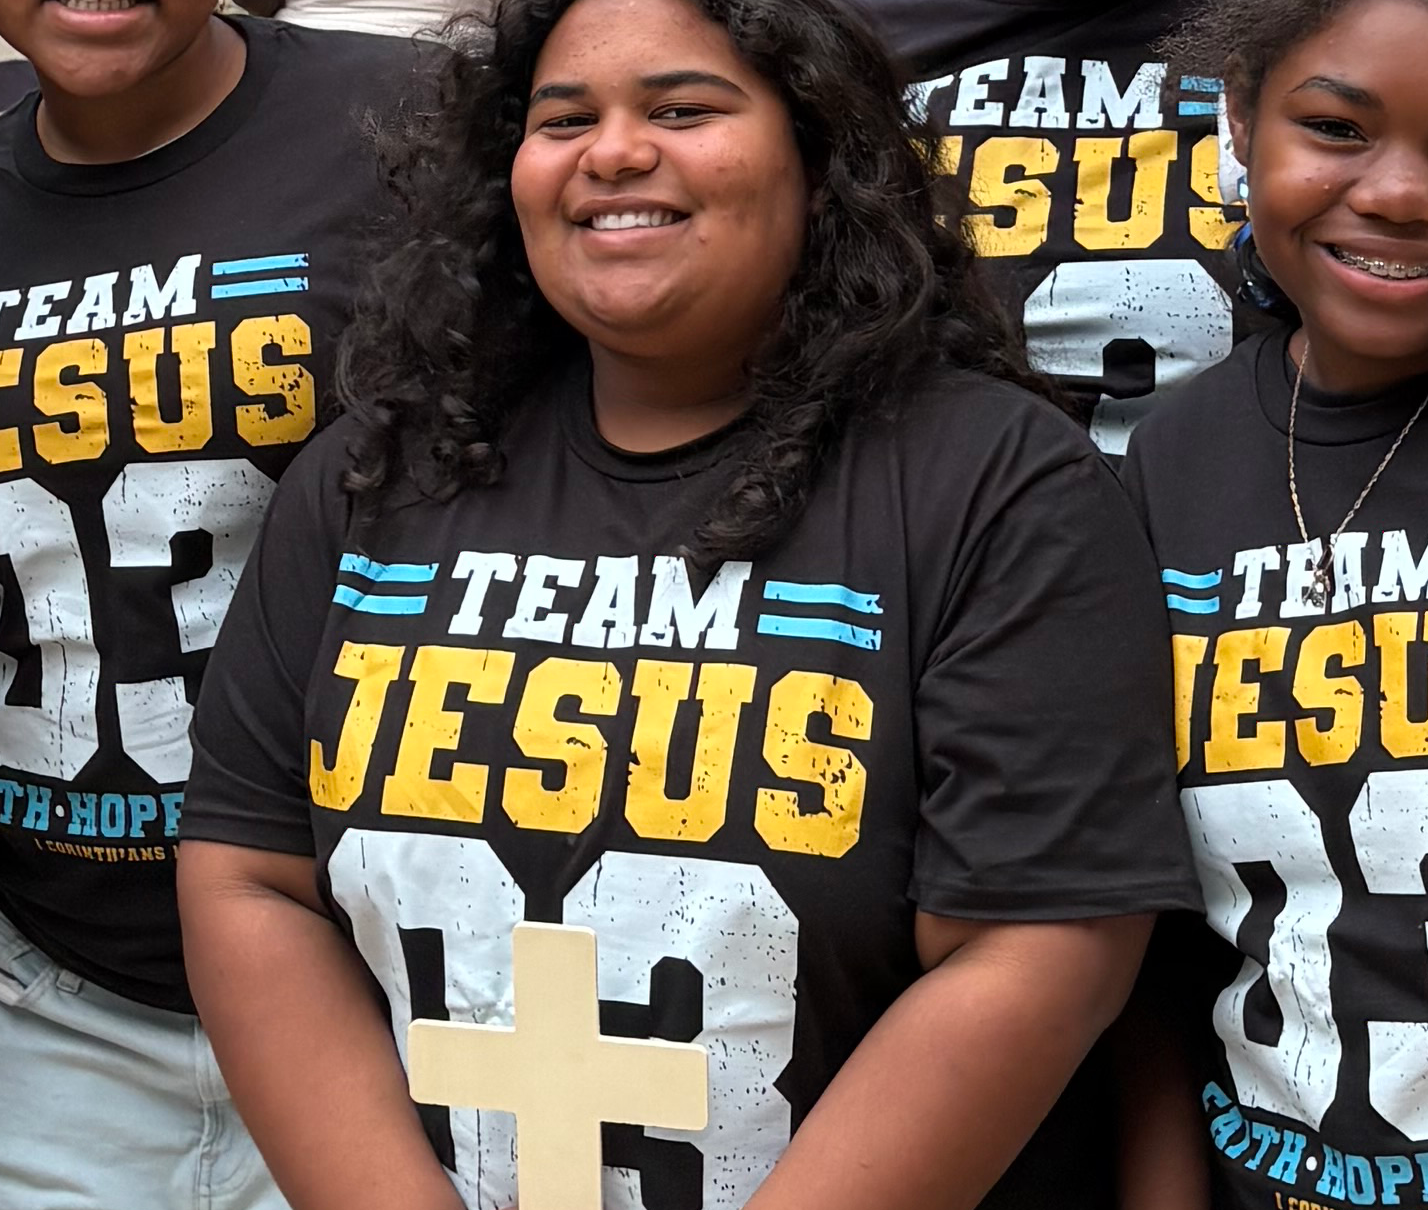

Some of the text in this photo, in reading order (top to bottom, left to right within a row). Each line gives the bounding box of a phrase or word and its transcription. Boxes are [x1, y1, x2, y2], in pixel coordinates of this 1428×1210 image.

[902, 55, 1168, 130] TEAM
[912, 129, 1250, 257] SUS
[448, 551, 753, 650] TEAM
[308, 640, 874, 859] JESUS
